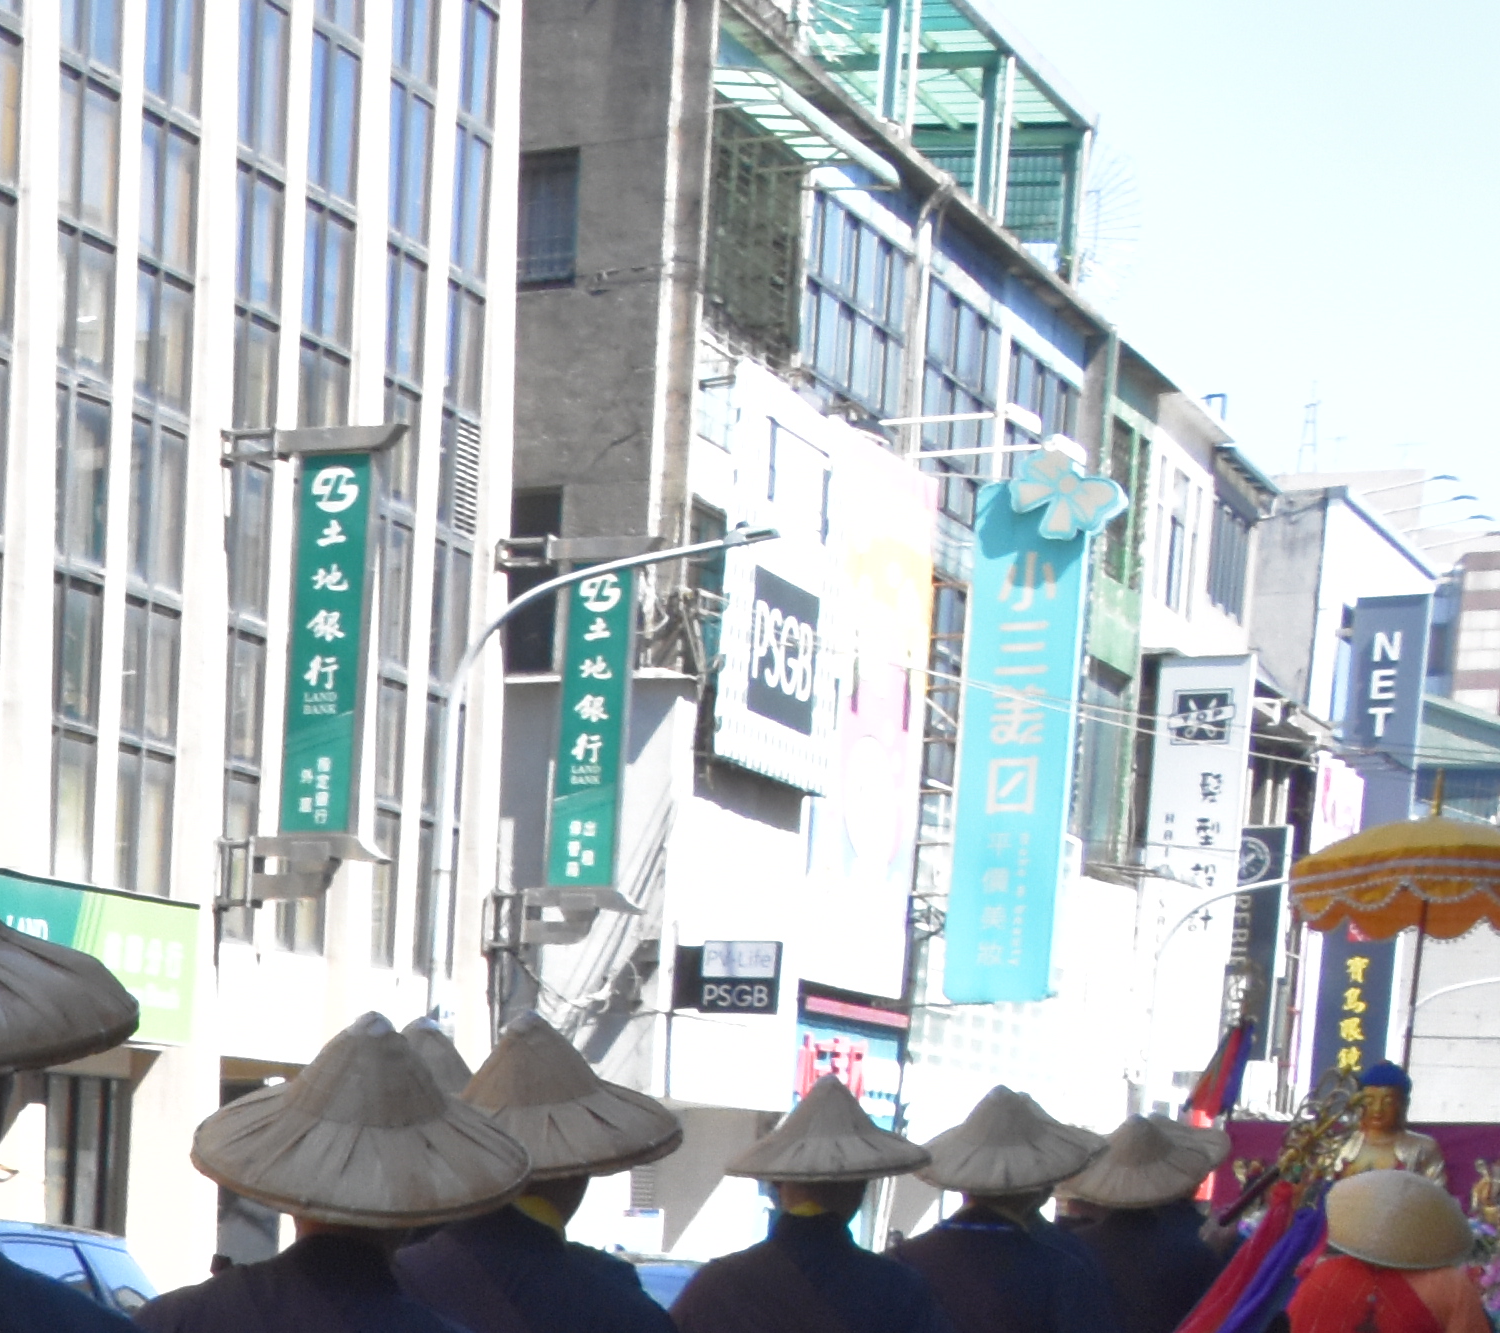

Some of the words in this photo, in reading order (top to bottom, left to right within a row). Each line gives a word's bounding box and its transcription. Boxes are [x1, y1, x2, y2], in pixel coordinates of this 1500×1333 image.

[303, 520, 349, 691] 土地銀行
[749, 599, 813, 704] PSGB
[571, 618, 613, 764] 土地銀行
[1367, 631, 1404, 738] NET
[702, 983, 769, 1008] PSGB
